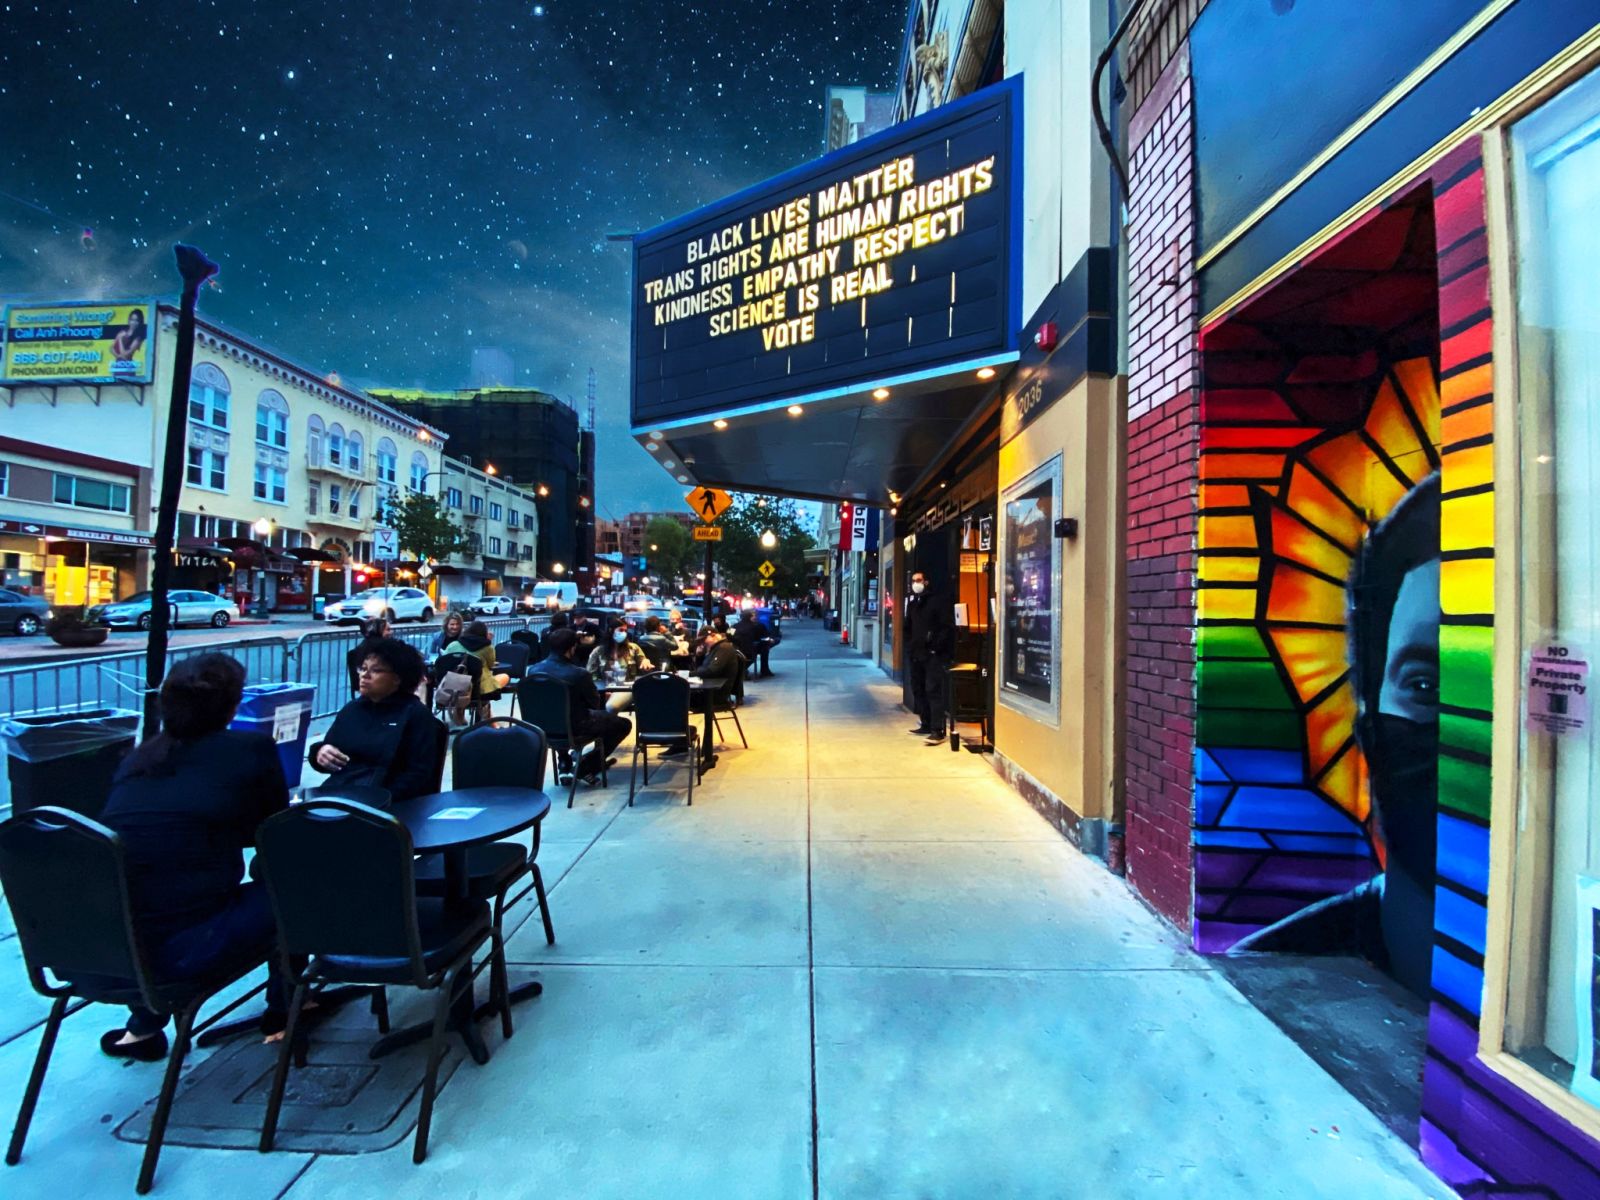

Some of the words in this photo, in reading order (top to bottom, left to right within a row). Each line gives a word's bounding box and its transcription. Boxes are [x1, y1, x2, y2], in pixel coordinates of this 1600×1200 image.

[687, 222, 743, 264] BLACK
[750, 193, 811, 241] LIVES
[818, 156, 915, 215] MATTER
[645, 268, 695, 304] TRANS
[700, 247, 762, 285] RIGHTS
[769, 228, 808, 264] ARE
[816, 197, 893, 248] HUMAN
[898, 157, 995, 221] RIGHTS
[654, 284, 732, 326] KINDNESS
[742, 249, 840, 301] EMPATHY
[853, 203, 964, 266] RESPECT
[709, 290, 785, 337] SCIENCE
[798, 284, 819, 314] IS
[831, 261, 893, 305] REAL
[15, 329, 34, 339] Call
[36, 327, 57, 338] Anh
[60, 326, 103, 339] Phoong!
[762, 314, 814, 351] VOTE
[11, 366, 98, 376] PHOONGLAW.COM
[1018, 379, 1042, 421] 2036
[697, 529, 719, 537] AHEAD
[1547, 646, 1569, 657] NO
[1531, 678, 1587, 695] Property
[1535, 667, 1582, 681] Private
